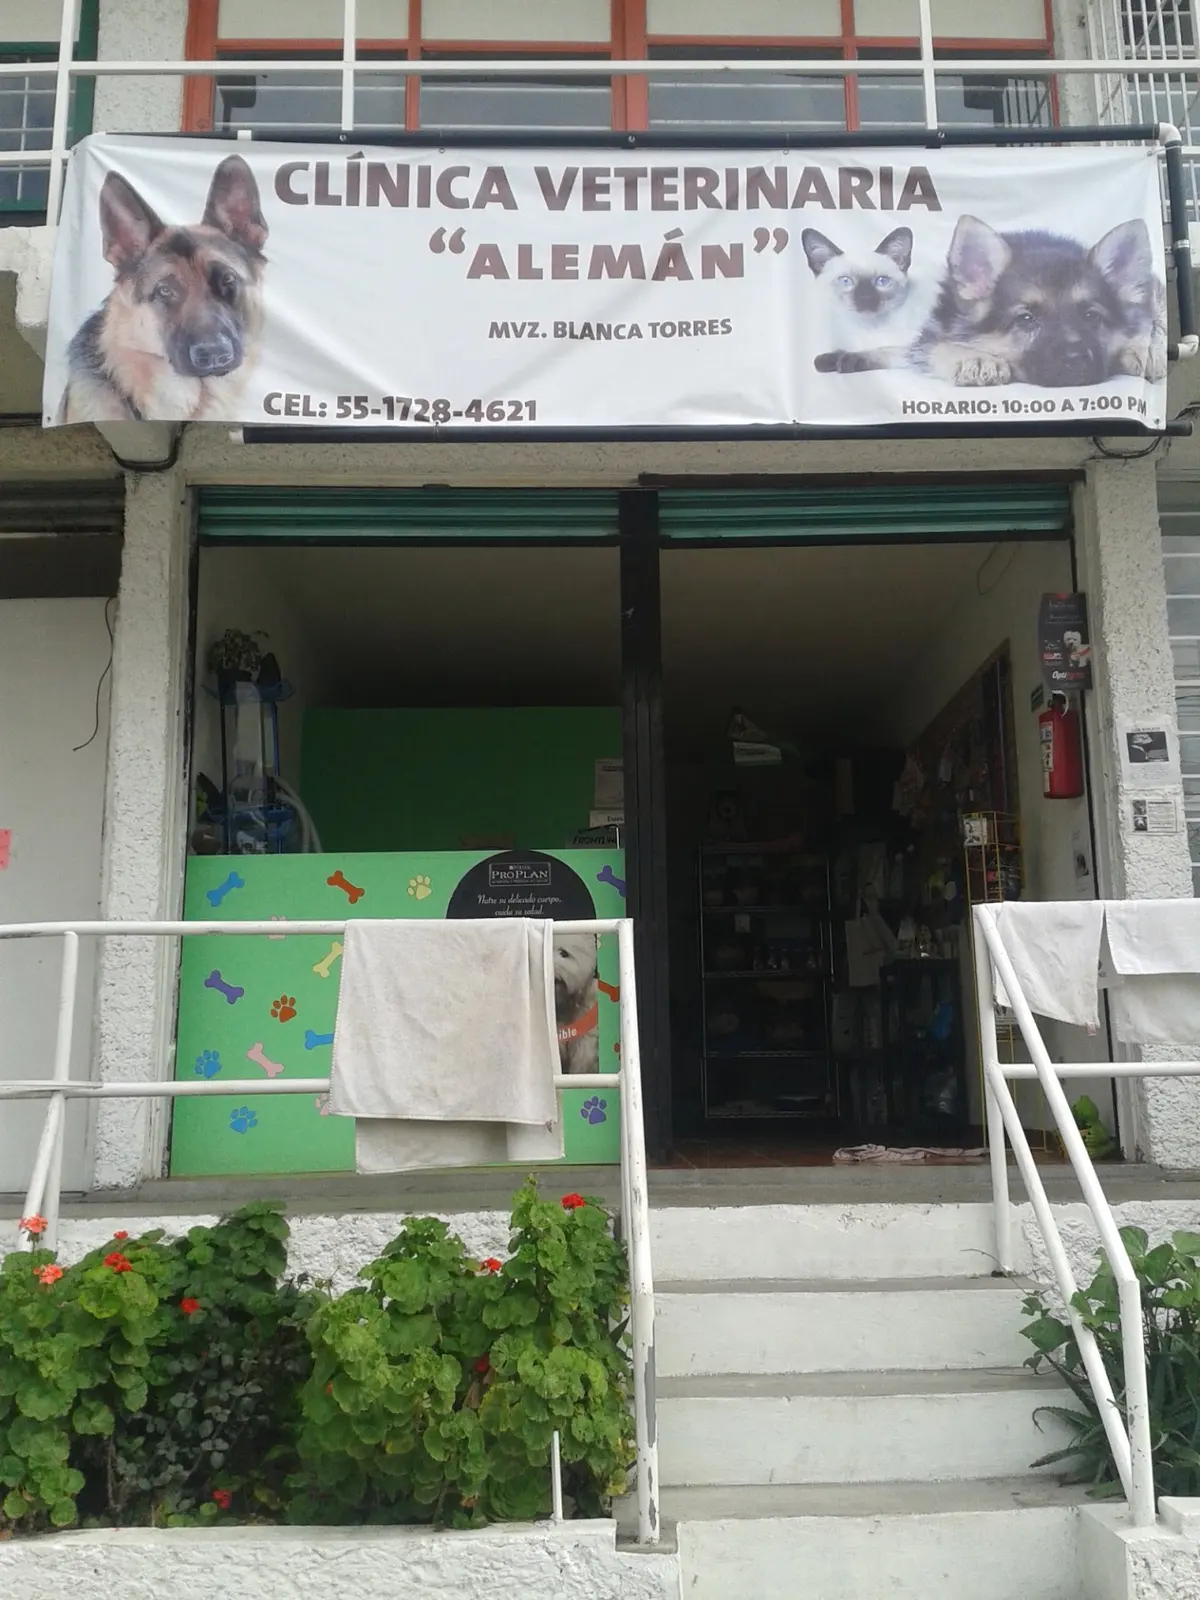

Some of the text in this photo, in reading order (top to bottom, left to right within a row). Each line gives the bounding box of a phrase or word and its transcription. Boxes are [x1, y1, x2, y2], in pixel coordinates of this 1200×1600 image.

[274, 150, 943, 212] CLÍNICA VETERINARIA
[488, 318, 733, 340] MVZ. BLANCA TORRES
[263, 392, 537, 424] CEL: 55-1728-4621
[902, 395, 1147, 416] HORARIO: 10:00 A 7:00 PM
